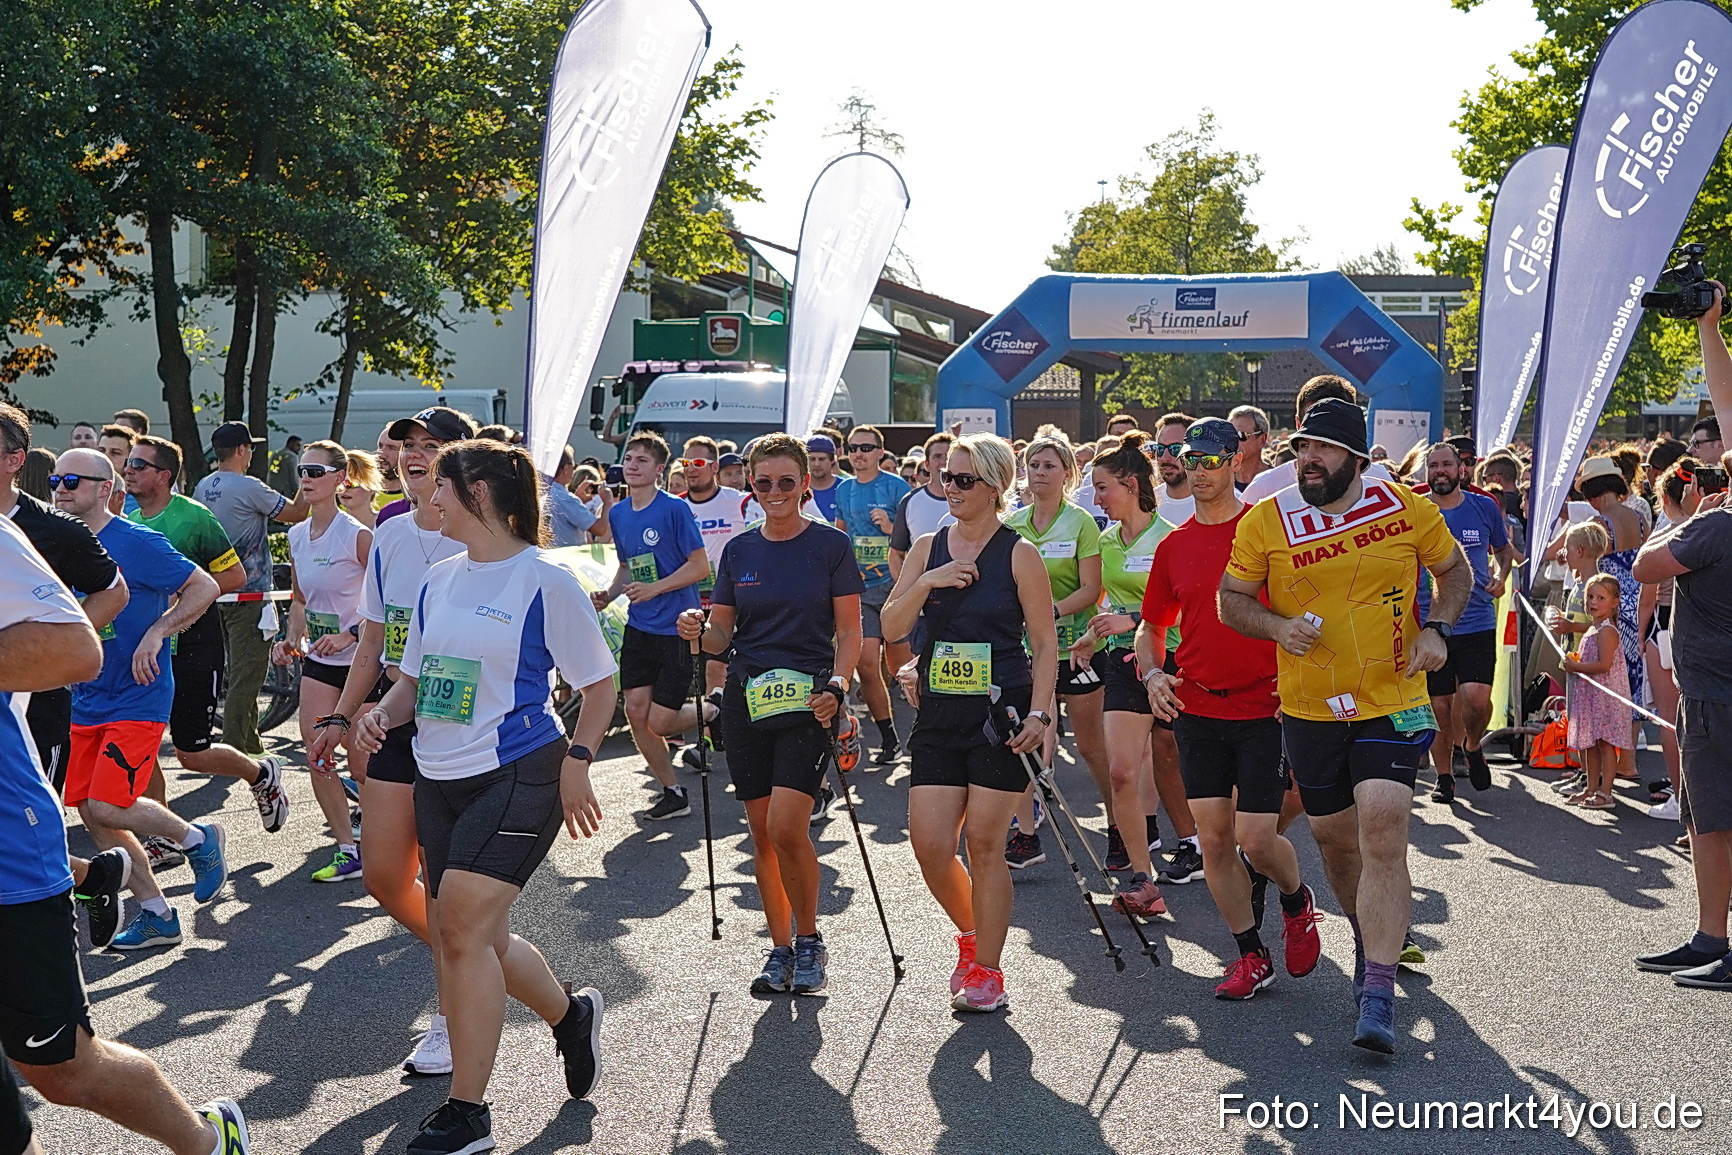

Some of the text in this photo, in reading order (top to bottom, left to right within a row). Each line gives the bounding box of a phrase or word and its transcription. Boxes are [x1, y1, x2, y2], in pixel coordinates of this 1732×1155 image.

[591, 16, 664, 164] Fischer
[625, 34, 677, 155] AUTOMOBILE
[1618, 38, 1704, 191] Fischer
[1655, 62, 1719, 185] AUTOMOBILE
[1518, 171, 1564, 276] Fischer
[1161, 310, 1250, 328] firmenlauf
[544, 245, 624, 454] www.fischer-automobile.de
[991, 338, 1039, 350] Fischer
[1494, 331, 1543, 450] fischer-automobile.de
[1551, 274, 1647, 487] www.fischer-automobile.de
[647, 400, 688, 409] abavent
[859, 546, 883, 556] 1927
[1291, 518, 1413, 569] MAX BÖGL
[740, 571, 758, 582] aha!
[489, 608, 513, 621] PETTER
[393, 626, 409, 645] 32
[941, 660, 974, 678] 489
[422, 676, 455, 700] 309
[761, 683, 797, 700] 485
[435, 700, 456, 711] Elena
[460, 685, 473, 716] 2022
[749, 690, 758, 714] WALK
[1402, 715, 1418, 723] Rosca
